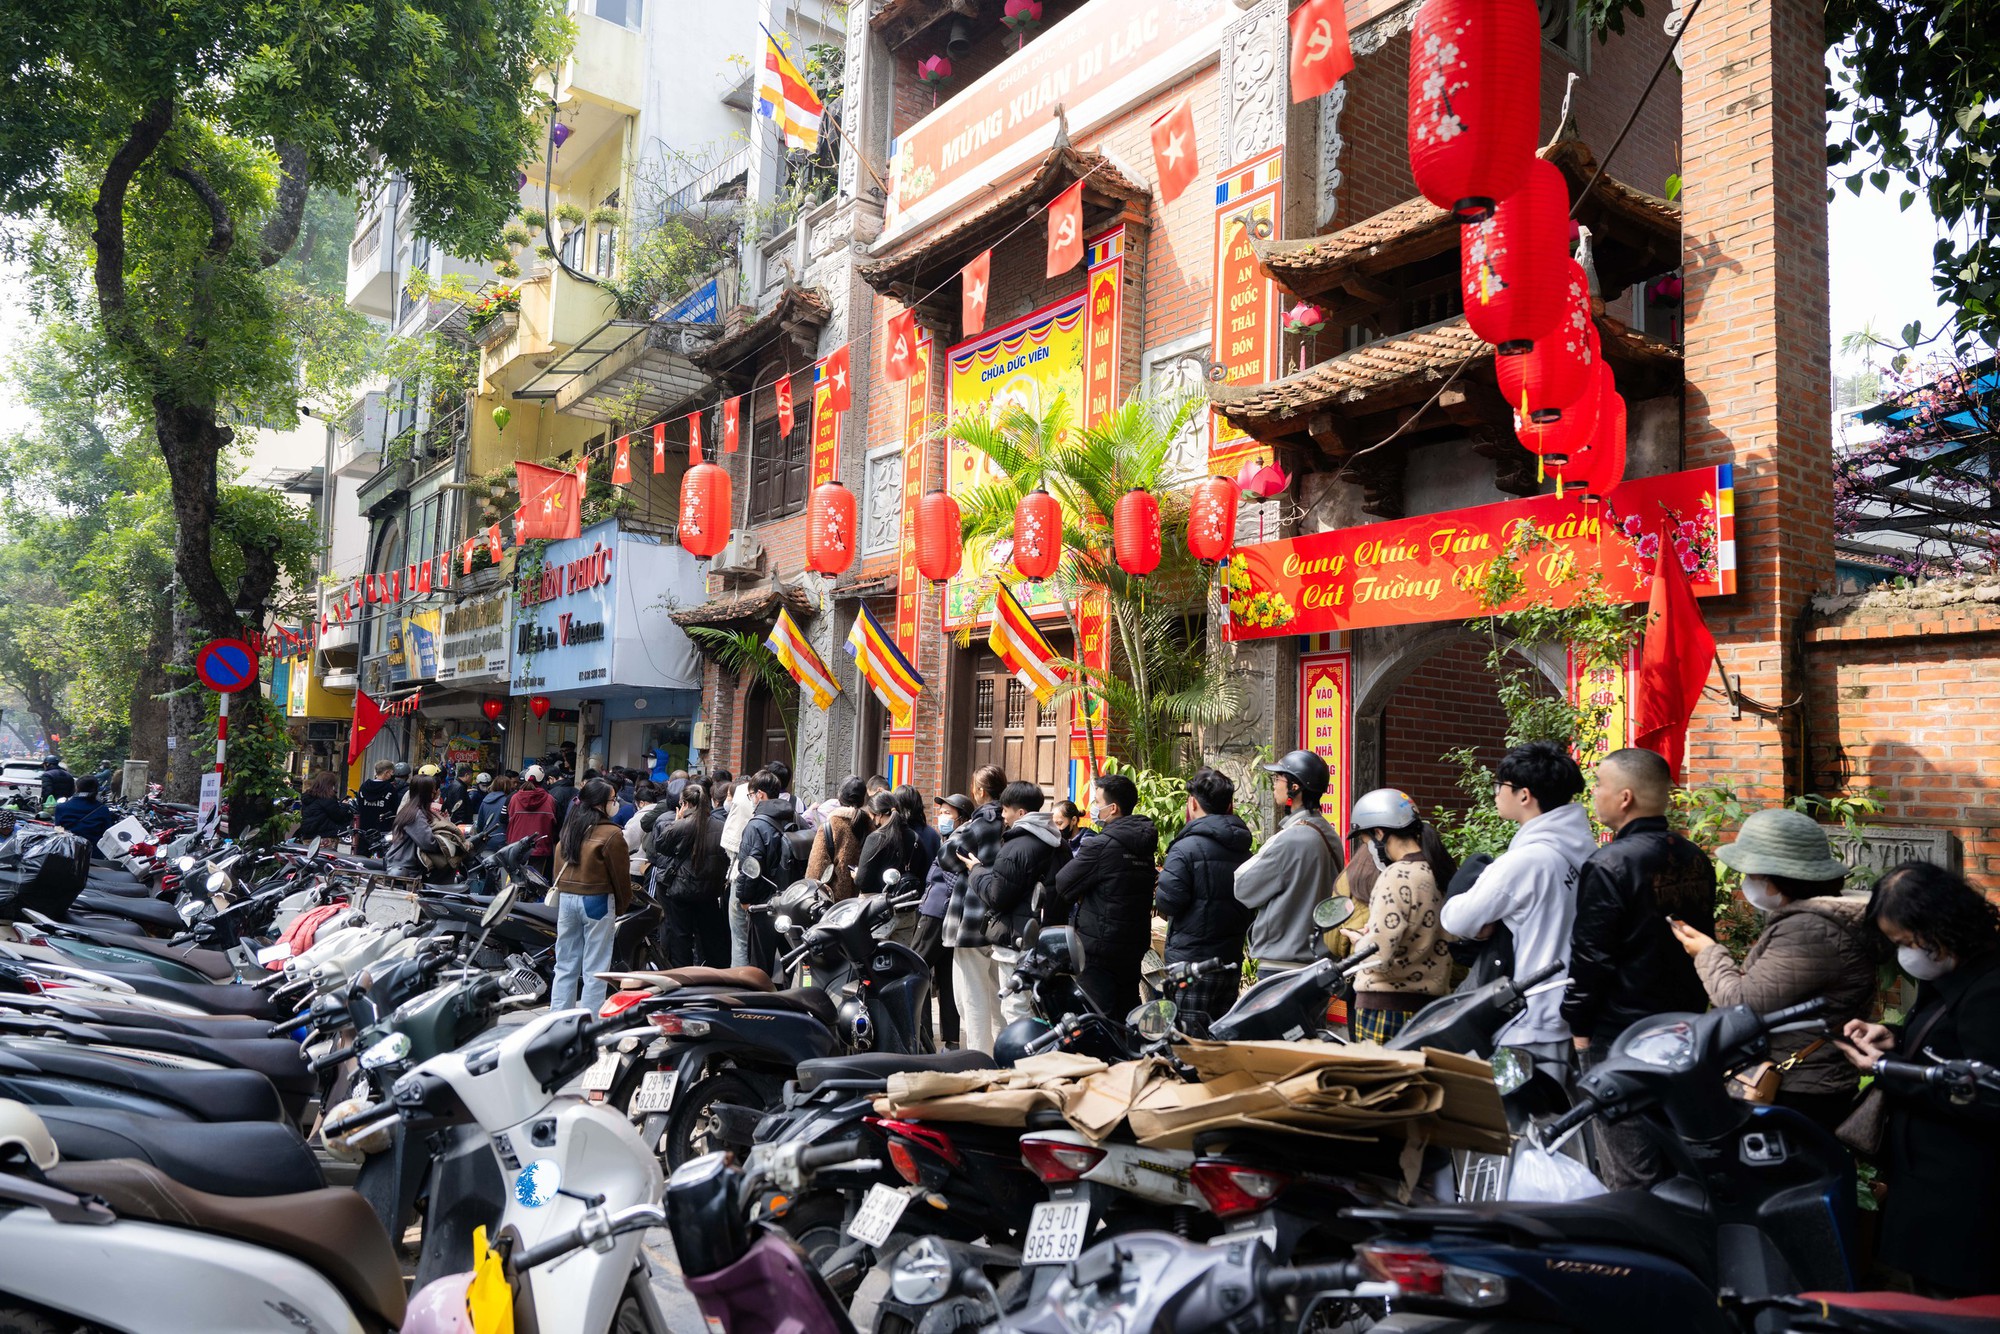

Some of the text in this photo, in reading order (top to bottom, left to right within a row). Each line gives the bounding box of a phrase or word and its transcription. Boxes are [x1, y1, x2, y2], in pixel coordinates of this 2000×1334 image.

[941, 107, 1003, 172] MỪNG
[1007, 62, 1073, 130] XUÂN
[1077, 42, 1104, 86] DI
[1237, 265, 1253, 284] AN
[1096, 292, 1111, 316] ĐÓN
[1230, 283, 1259, 311] QUỐC
[1231, 310, 1256, 333] THÁI
[1231, 336, 1255, 357] ĐÓN
[981, 345, 1050, 383] CHÙA ĐỨC VIÊN
[1282, 551, 1347, 578] Cung
[1353, 536, 1420, 568] Chúc
[1428, 527, 1492, 558] Tân
[566, 541, 613, 596] PHÚC
[1302, 583, 1345, 610] Cát
[1352, 573, 1443, 602] Tường
[1316, 686, 1333, 700] VÀO
[1315, 704, 1333, 719] NHÀ
[732, 1012, 776, 1021] VISION
[646, 1073, 673, 1091] 29-Y5
[638, 1092, 671, 1109] 828.78
[1027, 1233, 1078, 1259] 985.98
